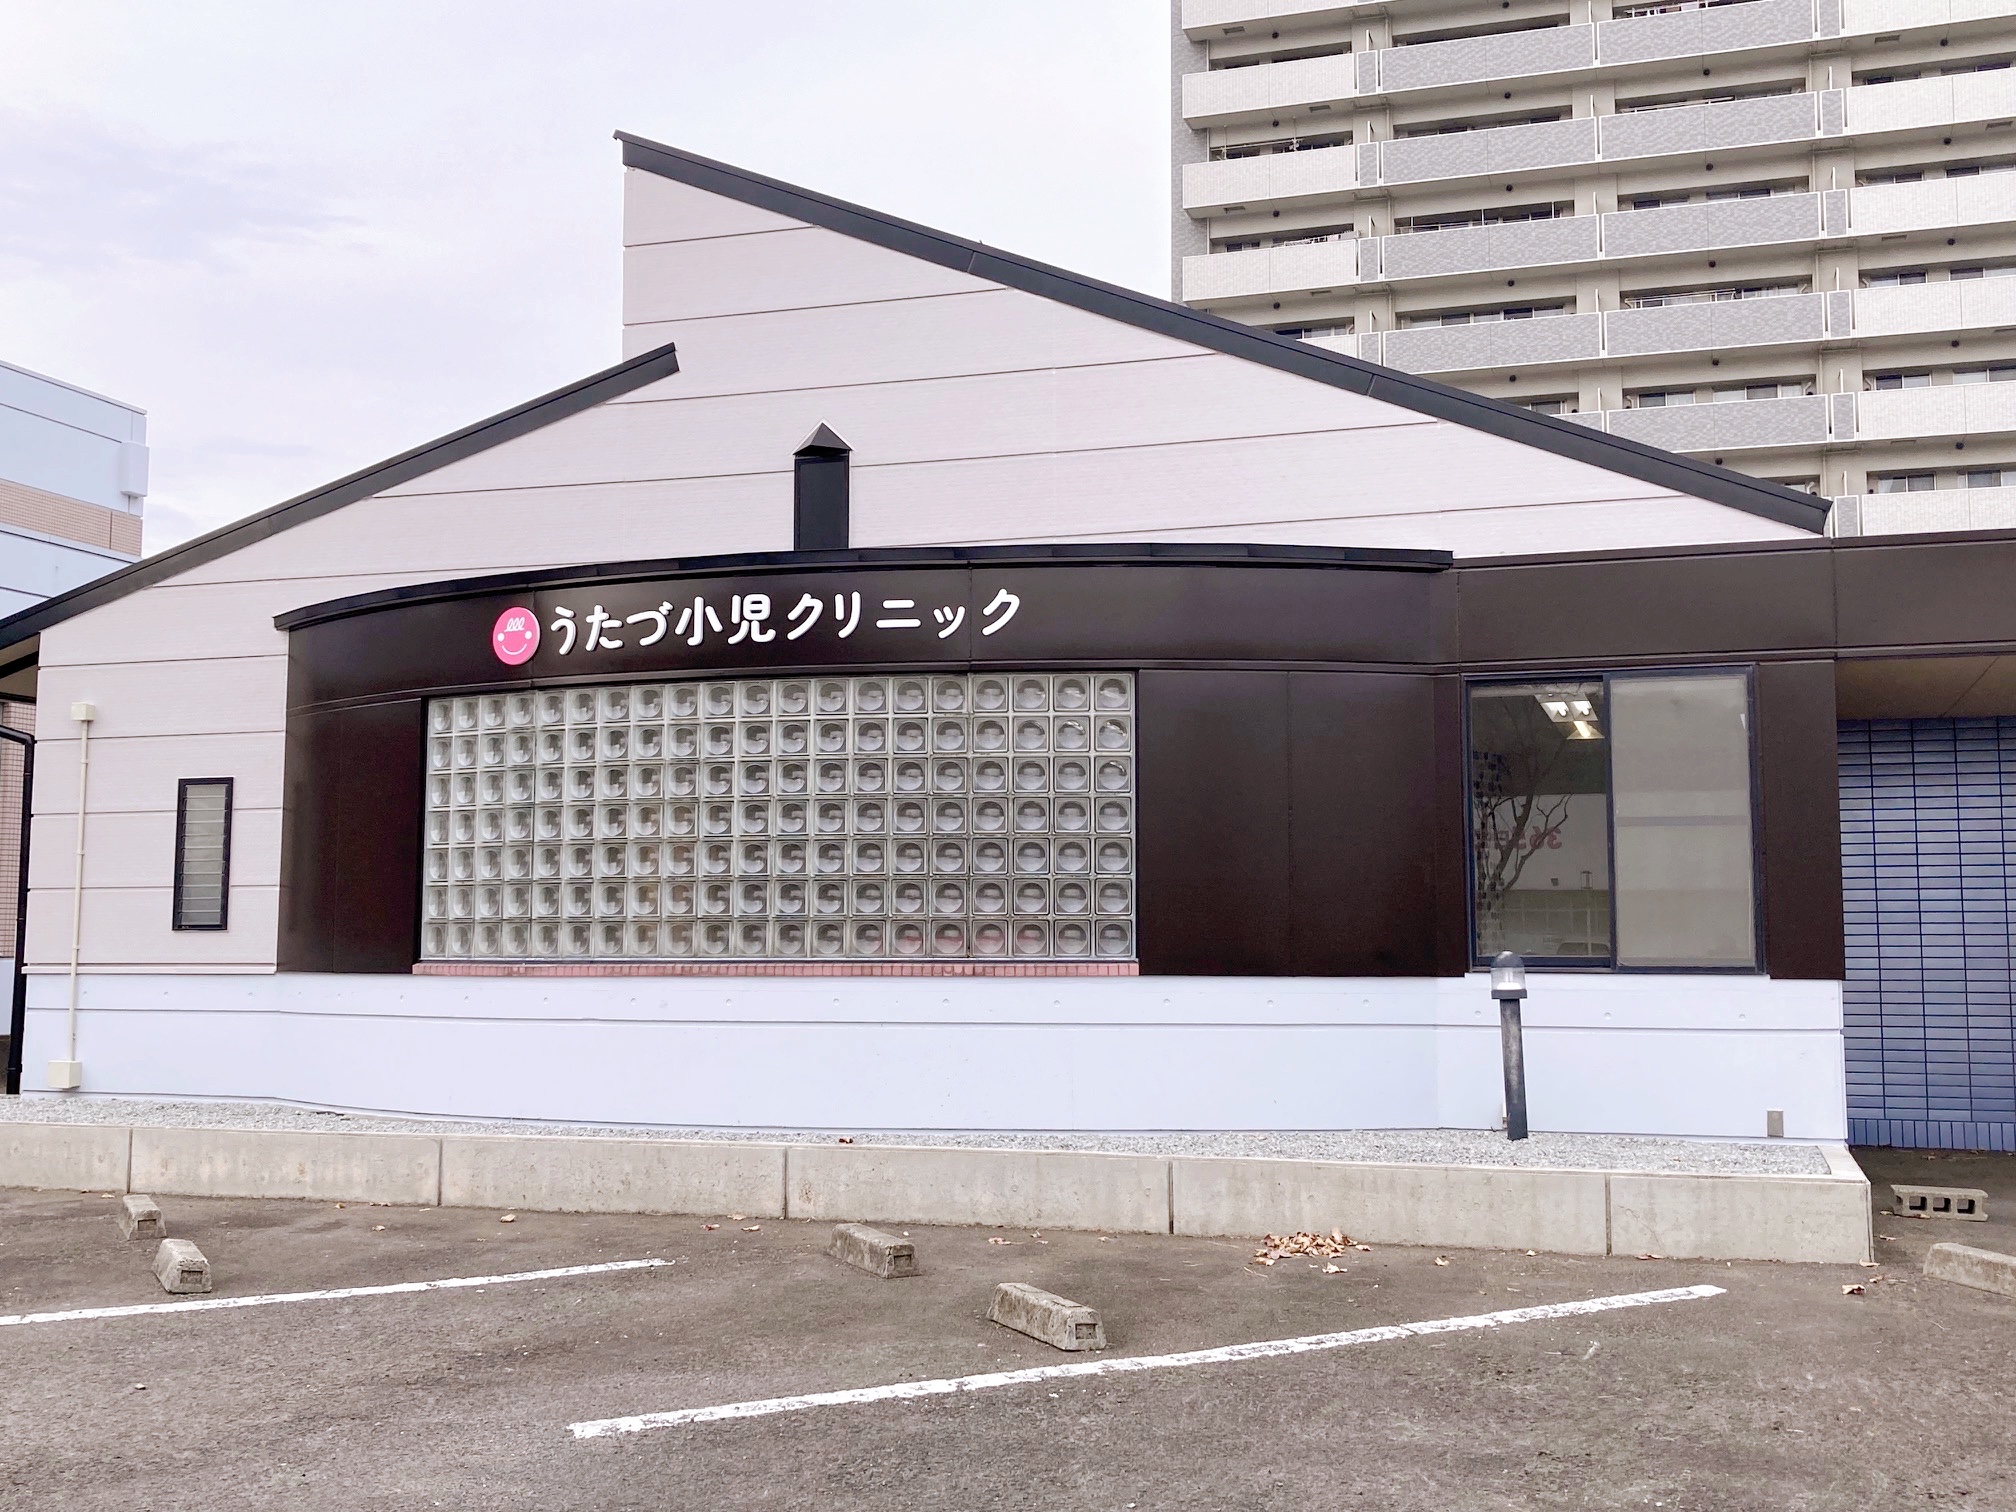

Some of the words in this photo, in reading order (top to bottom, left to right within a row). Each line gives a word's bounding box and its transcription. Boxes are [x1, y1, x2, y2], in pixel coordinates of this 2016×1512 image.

[550, 588, 1021, 656] うたづ小児クリニック
